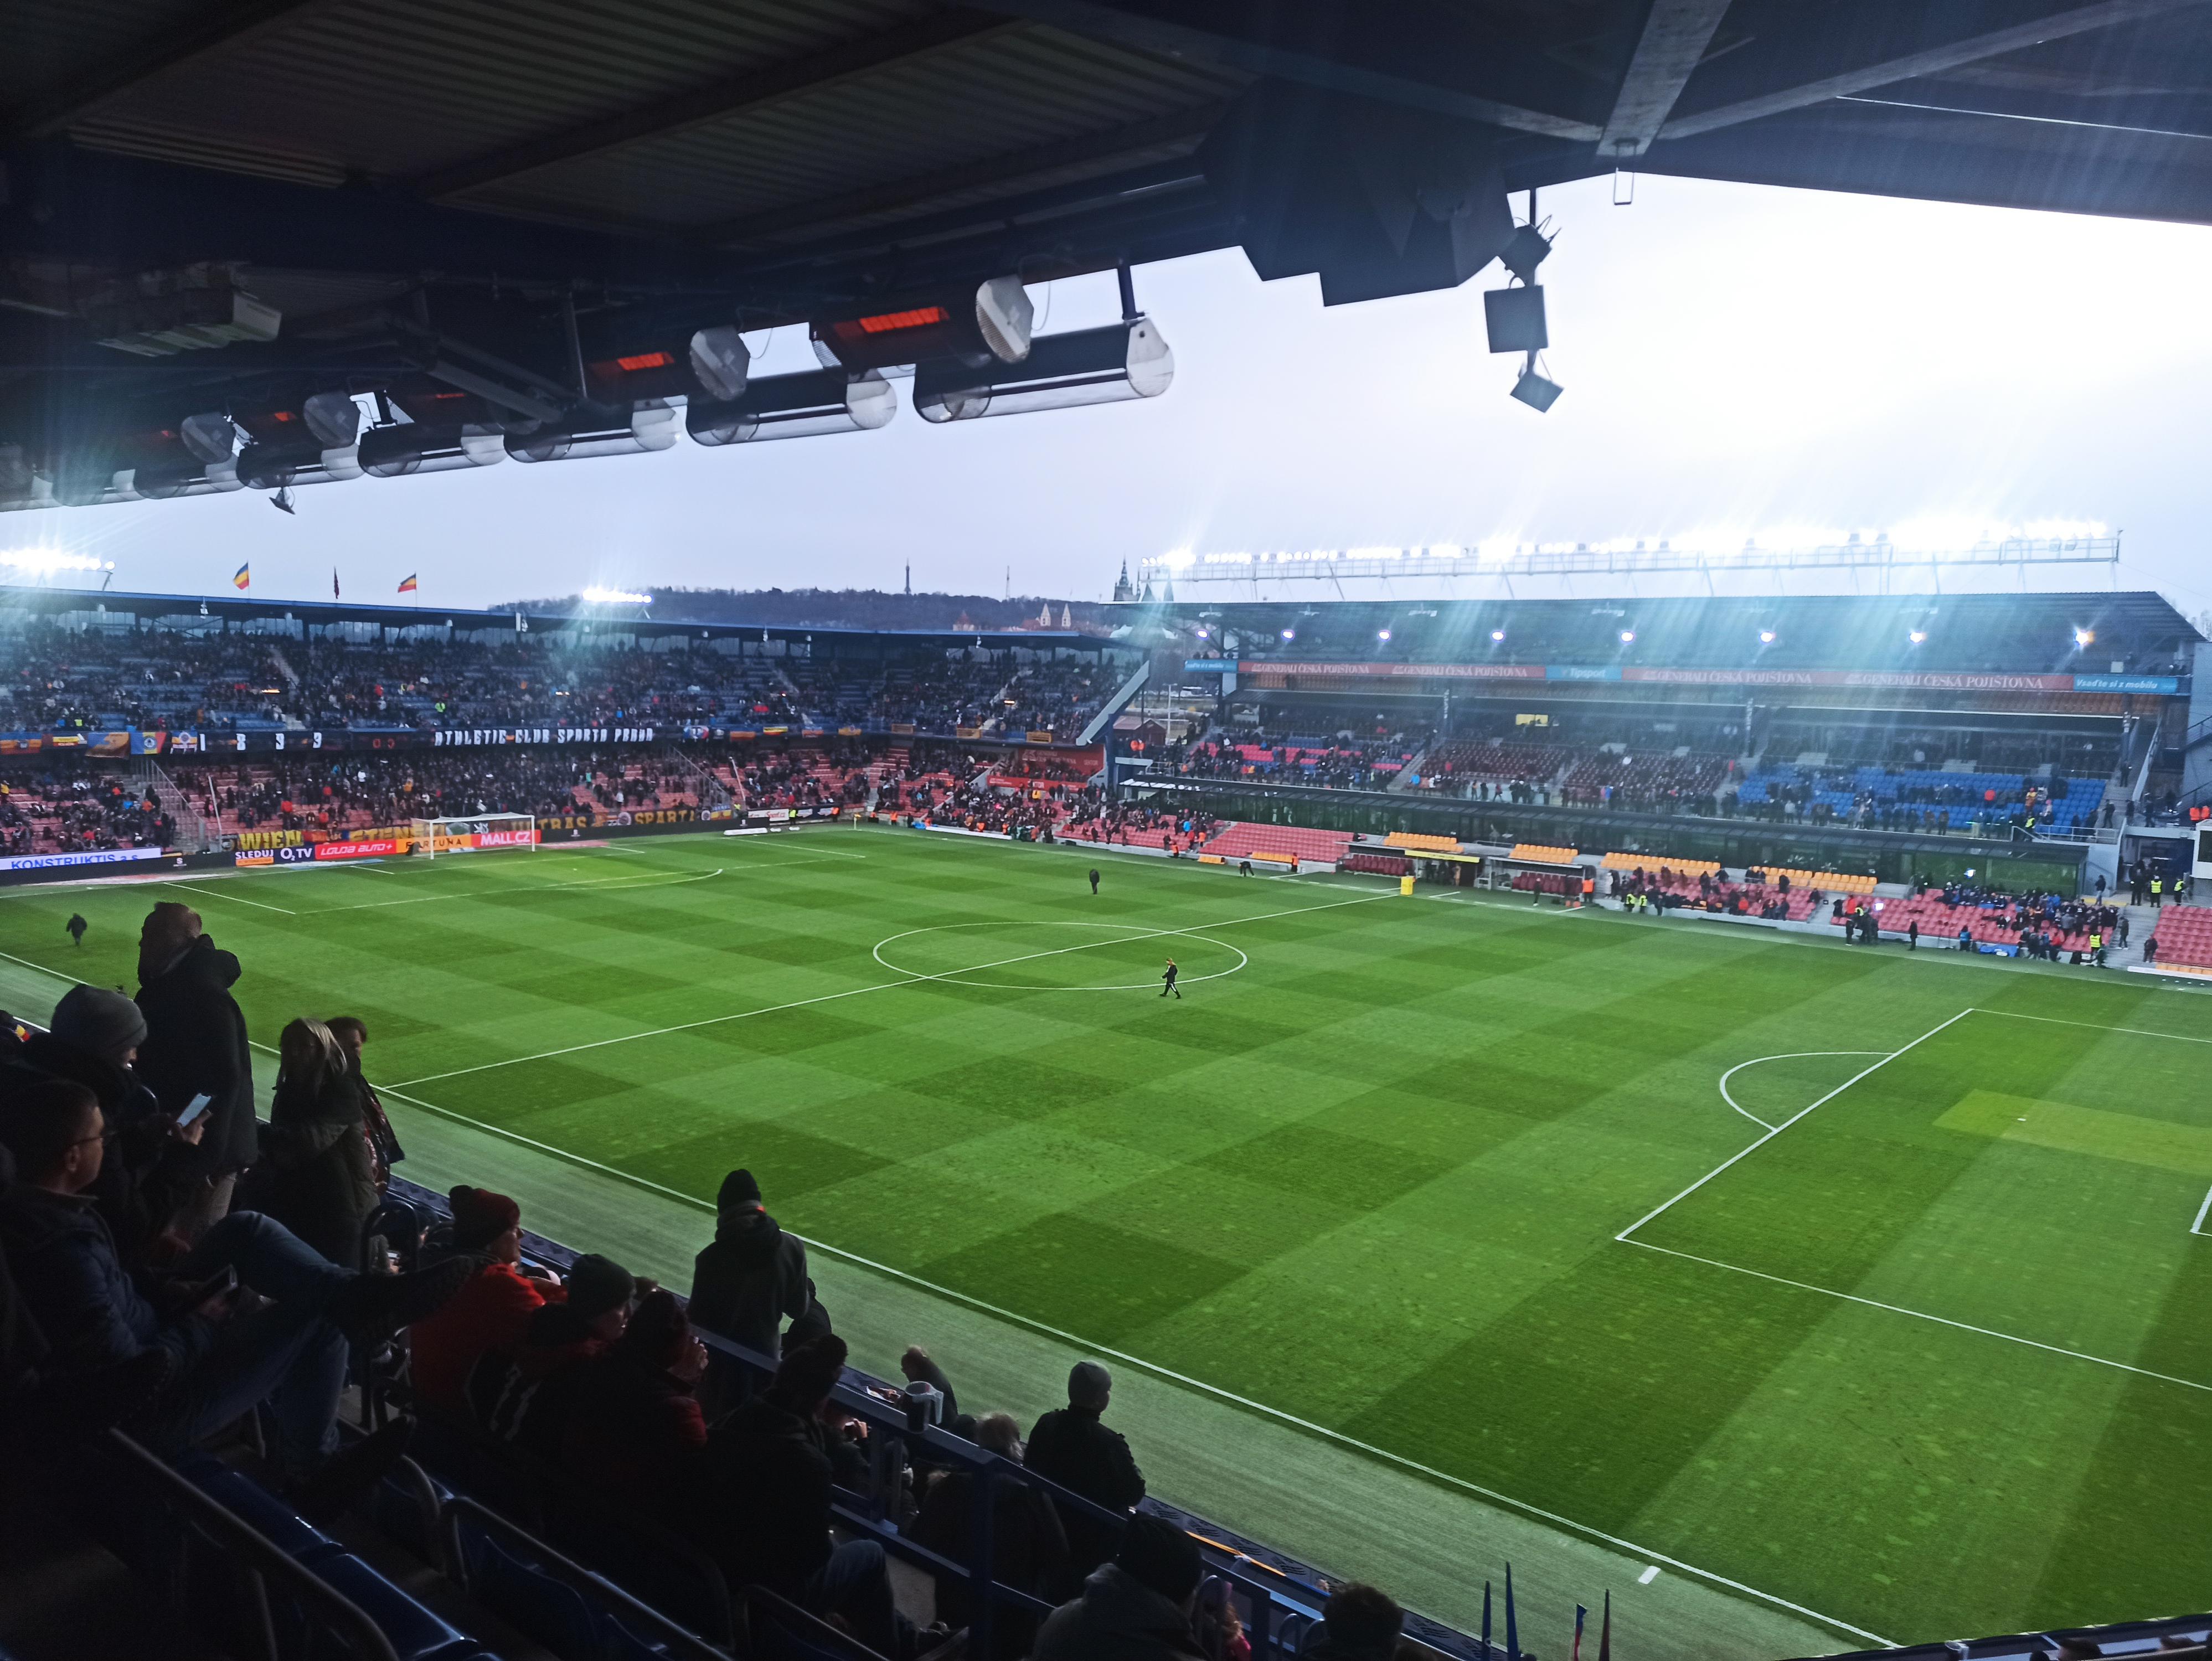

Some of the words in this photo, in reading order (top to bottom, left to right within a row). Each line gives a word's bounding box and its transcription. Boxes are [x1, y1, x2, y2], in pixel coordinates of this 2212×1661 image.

[1262, 664, 1297, 673] GENERALI
[1404, 665, 1445, 675] GENERALI
[1570, 668, 1606, 679] Tipsport
[1657, 670, 1707, 682] GENERALI
[1863, 674, 1920, 685] GENERALI
[1924, 674, 1962, 687] ČESKÁ
[1966, 675, 2043, 688] POJIŠŤOVNA
[2125, 680, 2158, 689] mobilu
[406, 838, 461, 849] FRTUNA
[481, 832, 530, 846] MALL.CZ
[235, 849, 274, 859] SLEDUJ
[296, 848, 312, 858] TV
